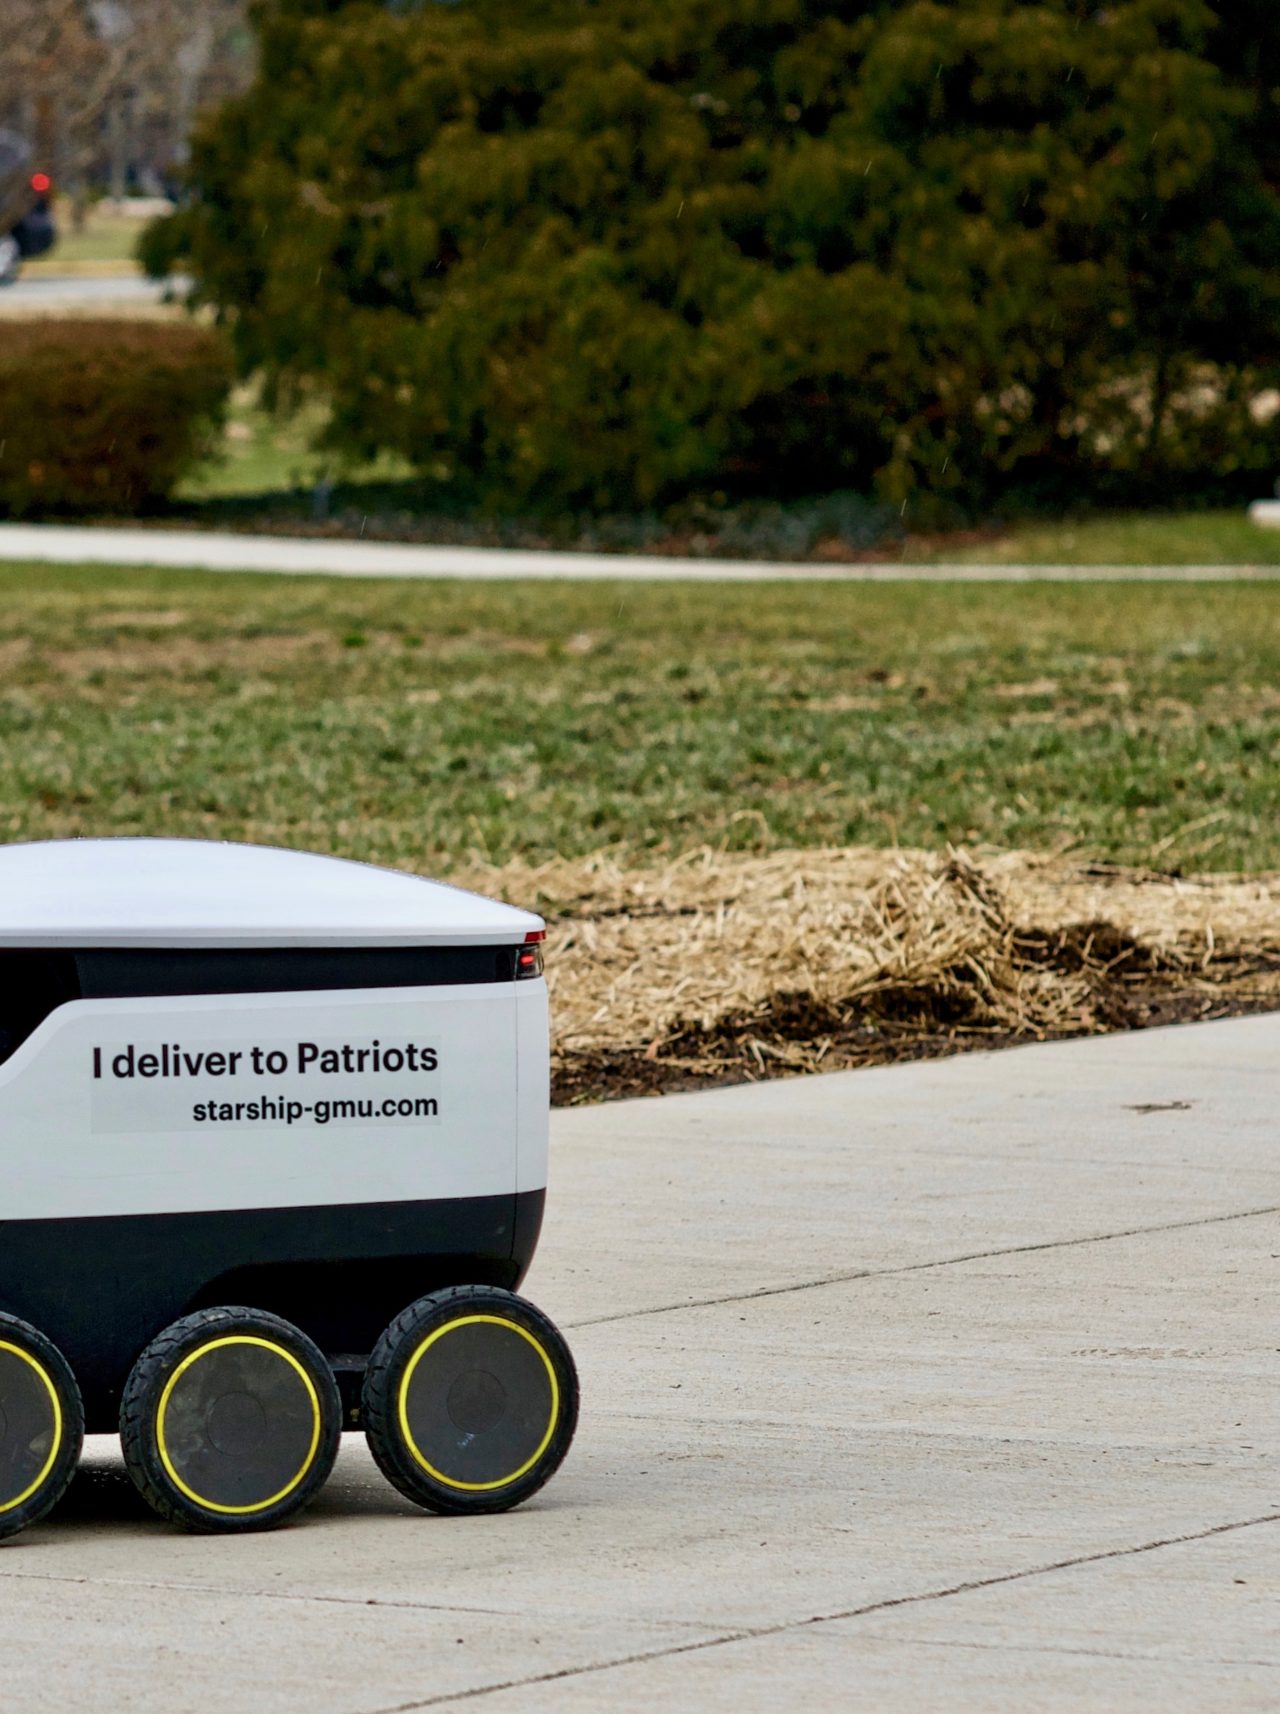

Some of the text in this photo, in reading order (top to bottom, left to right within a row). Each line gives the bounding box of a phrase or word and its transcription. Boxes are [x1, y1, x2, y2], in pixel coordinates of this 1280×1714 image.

[93, 1039, 439, 1079] I deliver to Patriots
[192, 1095, 439, 1125] starship-gmu.com
